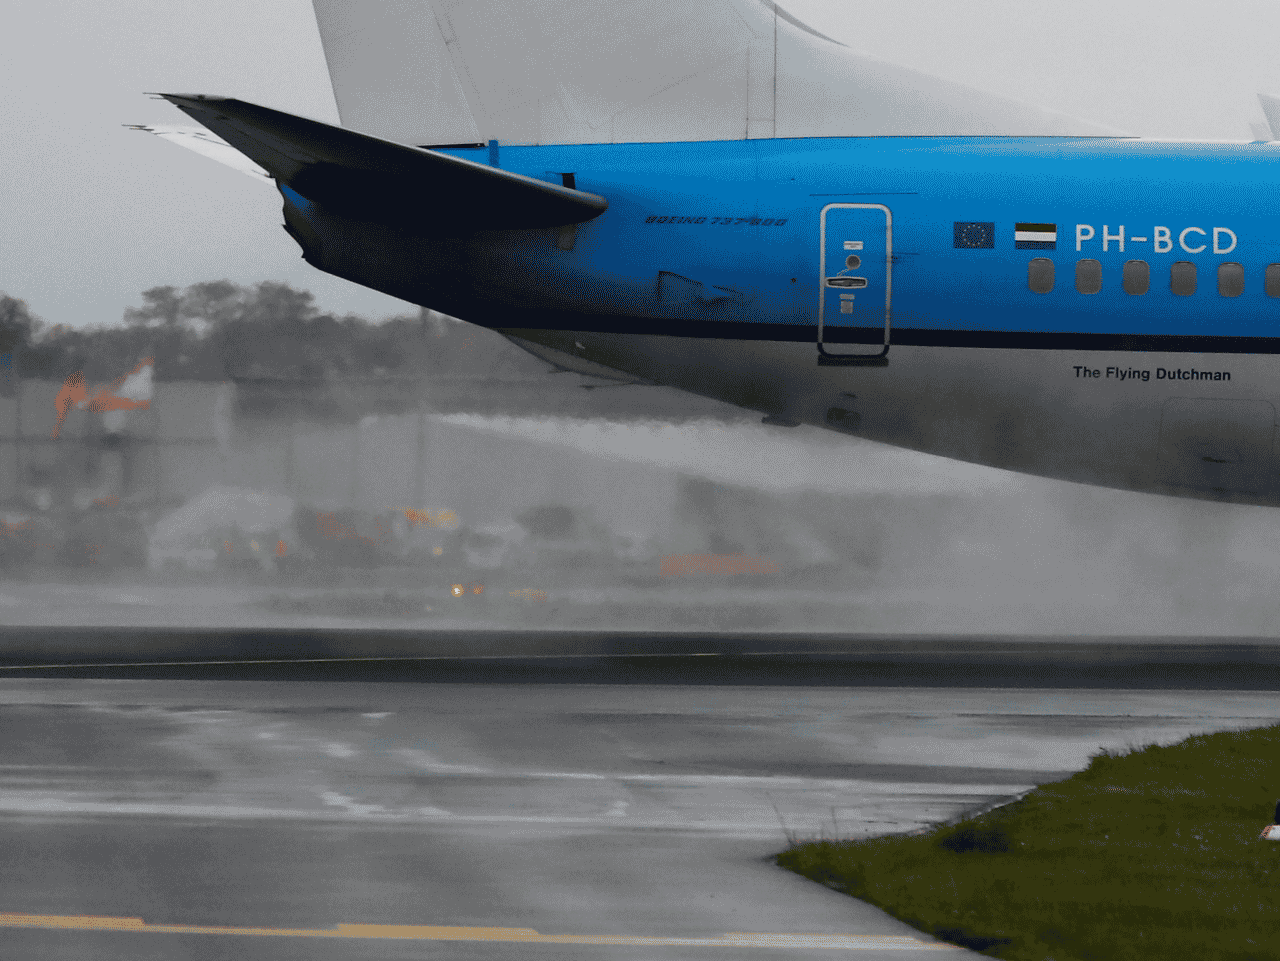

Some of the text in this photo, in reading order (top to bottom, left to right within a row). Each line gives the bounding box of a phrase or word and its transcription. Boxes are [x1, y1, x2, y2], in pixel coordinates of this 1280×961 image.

[1075, 223, 1238, 255] PH-BCD
[1073, 365, 1231, 381] The Flying Dutchman
